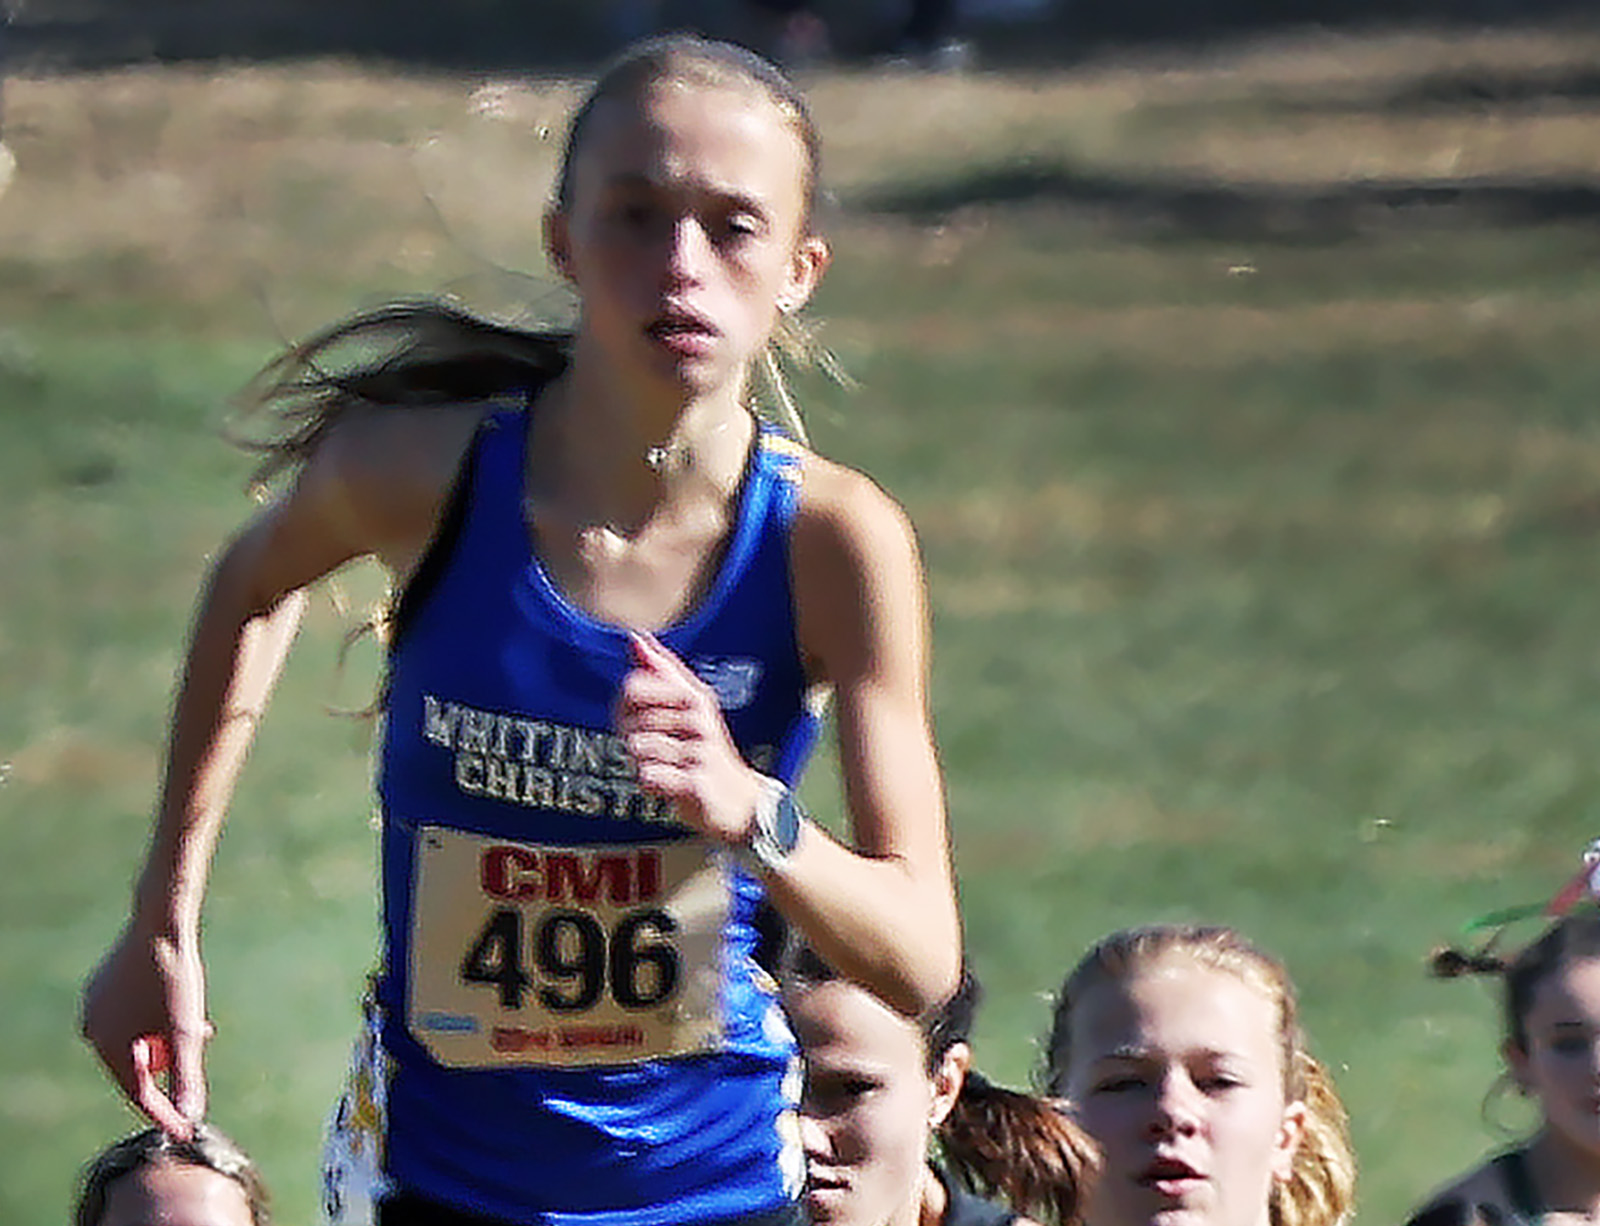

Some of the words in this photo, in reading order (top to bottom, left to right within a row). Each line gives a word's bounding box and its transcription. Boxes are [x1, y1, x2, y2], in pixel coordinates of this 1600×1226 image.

[422, 694, 639, 778] WHITINS
[481, 846, 662, 900] CMI
[462, 906, 678, 1010] 496
